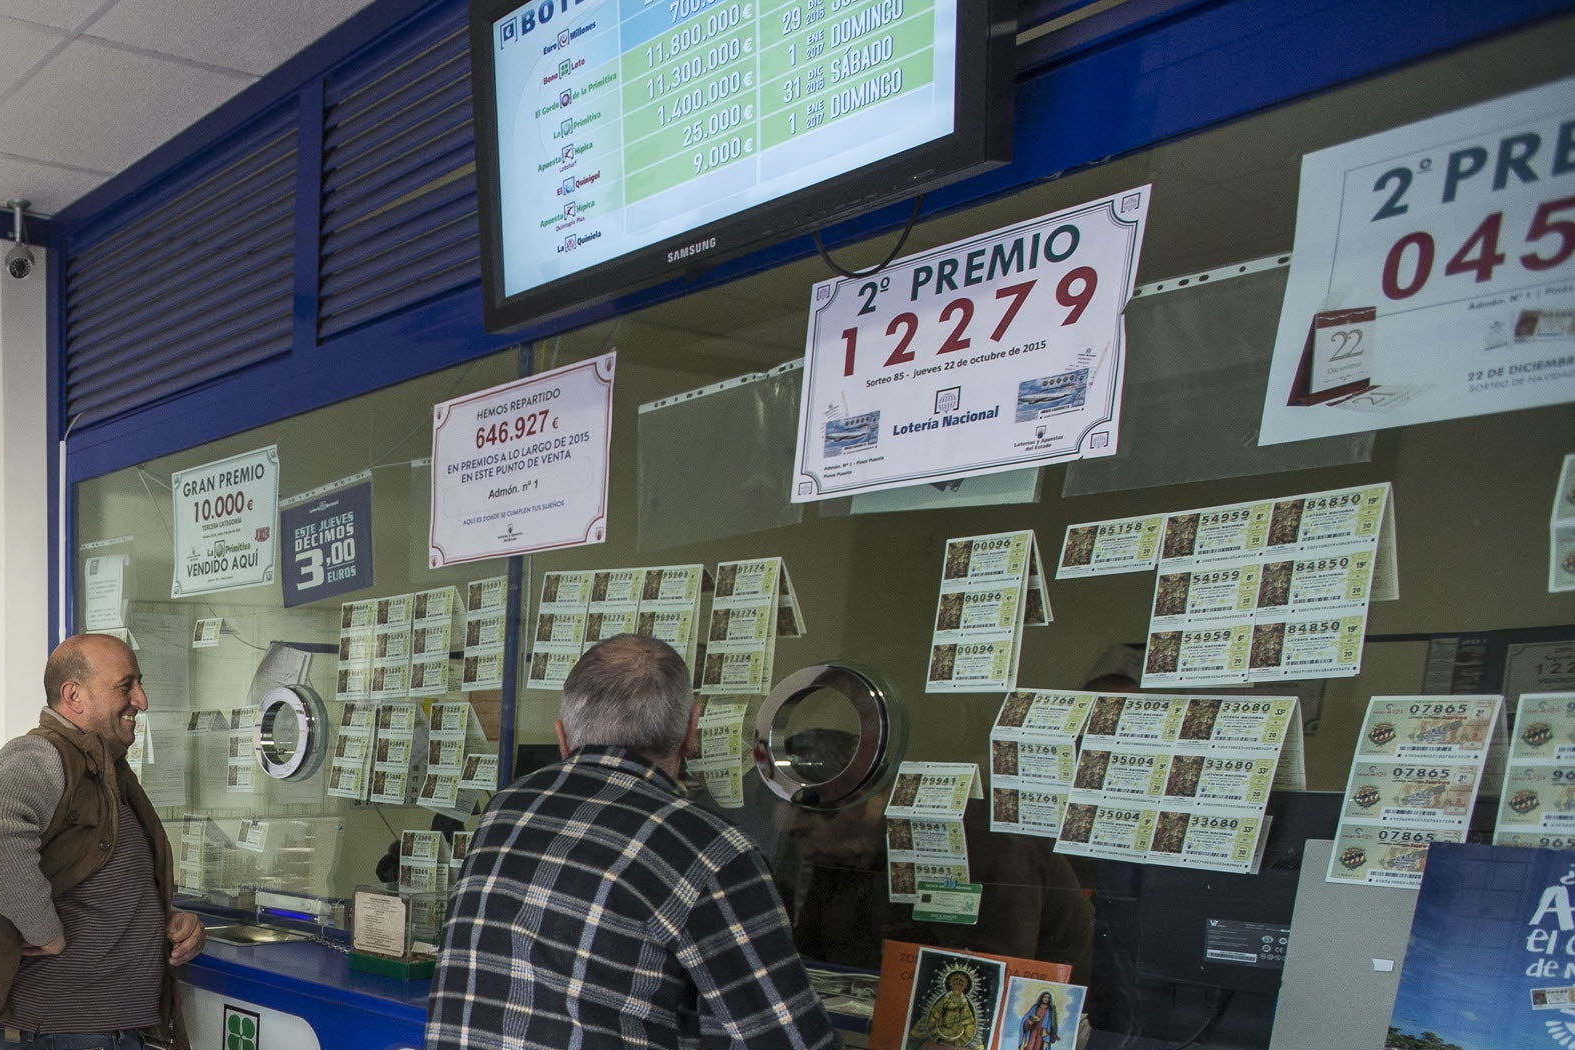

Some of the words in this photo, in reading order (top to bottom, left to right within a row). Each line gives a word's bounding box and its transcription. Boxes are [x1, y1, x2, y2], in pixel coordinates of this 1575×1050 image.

[783, 6, 802, 35] 29
[831, 0, 903, 48] DOMINGO
[543, 43, 557, 55] Euro
[570, 21, 596, 41] Millones
[646, 3, 740, 68] 11.800.000
[742, 3, 753, 19] €
[807, 30, 824, 46] ENE
[788, 43, 796, 66] 1
[806, 42, 825, 60] 2017
[543, 73, 558, 85] Bono
[571, 58, 585, 70] Loto
[647, 37, 741, 99] 11.300.000
[743, 37, 753, 53] €
[785, 77, 801, 103] 31
[808, 66, 824, 80] DIC
[831, 35, 893, 83] SÁBADO
[540, 101, 559, 115] Gordo
[588, 72, 617, 92] Primitiva
[657, 71, 741, 126] 1.400.000
[743, 71, 753, 87] €
[831, 68, 903, 119] DOMINGO
[808, 100, 824, 115] ENE
[553, 131, 561, 139] La
[573, 111, 602, 128] Primitiva
[683, 104, 741, 147] 25.000
[743, 104, 753, 120] €
[788, 112, 796, 135] 1
[806, 113, 825, 130] 2017
[538, 157, 562, 172] Apuesta
[693, 137, 741, 174] 9.000
[743, 138, 753, 153] €
[557, 187, 562, 196] El
[576, 170, 601, 188] Quinigol
[540, 214, 563, 228] Apuesta
[557, 244, 564, 253] La
[577, 230, 601, 246] Quiniela
[667, 237, 717, 263] SAMSUNG
[857, 276, 890, 317] 2º
[910, 224, 1080, 302] PREMIO
[1329, 329, 1365, 362] 22
[865, 374, 892, 389] Sorteo
[893, 371, 904, 382] 85
[912, 364, 942, 379] jueves
[944, 360, 955, 372] 22
[957, 357, 968, 368] de
[969, 349, 1006, 366] octubre
[1008, 346, 1021, 358] de
[1022, 339, 1047, 354] 2015
[1468, 371, 1483, 382] 22
[1487, 367, 1504, 379] DE
[477, 405, 508, 420] HEMOS
[510, 388, 561, 412] REPARTIDO
[476, 409, 549, 449] 646.927
[552, 416, 559, 429] €
[892, 415, 939, 437] Lotería
[942, 405, 1000, 430] Nacional
[447, 463, 459, 475] EN
[461, 454, 499, 472] PREMIOS
[501, 452, 507, 461] A
[509, 449, 519, 460] LO
[521, 441, 552, 458] LARGO
[554, 438, 566, 449] DE
[569, 432, 590, 446] 2015
[461, 473, 473, 484] EN
[475, 467, 494, 481] ESTE
[496, 460, 525, 477] PUNTO
[527, 457, 539, 468] DE
[542, 450, 571, 465] VENTA
[183, 475, 215, 498] GRAN
[219, 463, 265, 489] PREMIO
[194, 491, 245, 523] 10.000
[247, 499, 253, 511] €
[1306, 494, 1361, 510] 84850
[483, 513, 500, 523] DONDE
[507, 507, 531, 518] CUMPLEN
[532, 504, 541, 513] TUS
[1201, 510, 1250, 525] 54959
[295, 524, 316, 539] ESTE
[319, 511, 354, 531] JUEVES
[1098, 522, 1144, 536] 85158
[207, 548, 214, 557] La
[225, 542, 251, 554] Primitiva
[973, 539, 1011, 552] 00096
[187, 558, 229, 578] VENDIDO
[231, 548, 259, 570] AQUÍ
[1296, 558, 1349, 572] 84850
[327, 565, 357, 583] EUROS
[1192, 570, 1240, 584] 54959
[965, 592, 1002, 604] 00096
[1184, 630, 1231, 643] 54959
[1288, 621, 1340, 635] 84850
[957, 645, 994, 656] 00096
[1036, 696, 1075, 705] 25768
[1126, 700, 1170, 711] 35004
[1222, 702, 1271, 713] 33680
[1409, 704, 1468, 714] 07865
[1020, 744, 1058, 755] 25768
[1111, 755, 1154, 768] 35004
[1205, 759, 1253, 771] 33680
[1392, 767, 1450, 778] 07865
[1020, 792, 1058, 803] 25768
[1098, 809, 1140, 821] 35004
[1191, 817, 1238, 829] 33680
[1378, 831, 1435, 842] 07865
[1526, 929, 1557, 954] el
[1526, 958, 1558, 978] de
